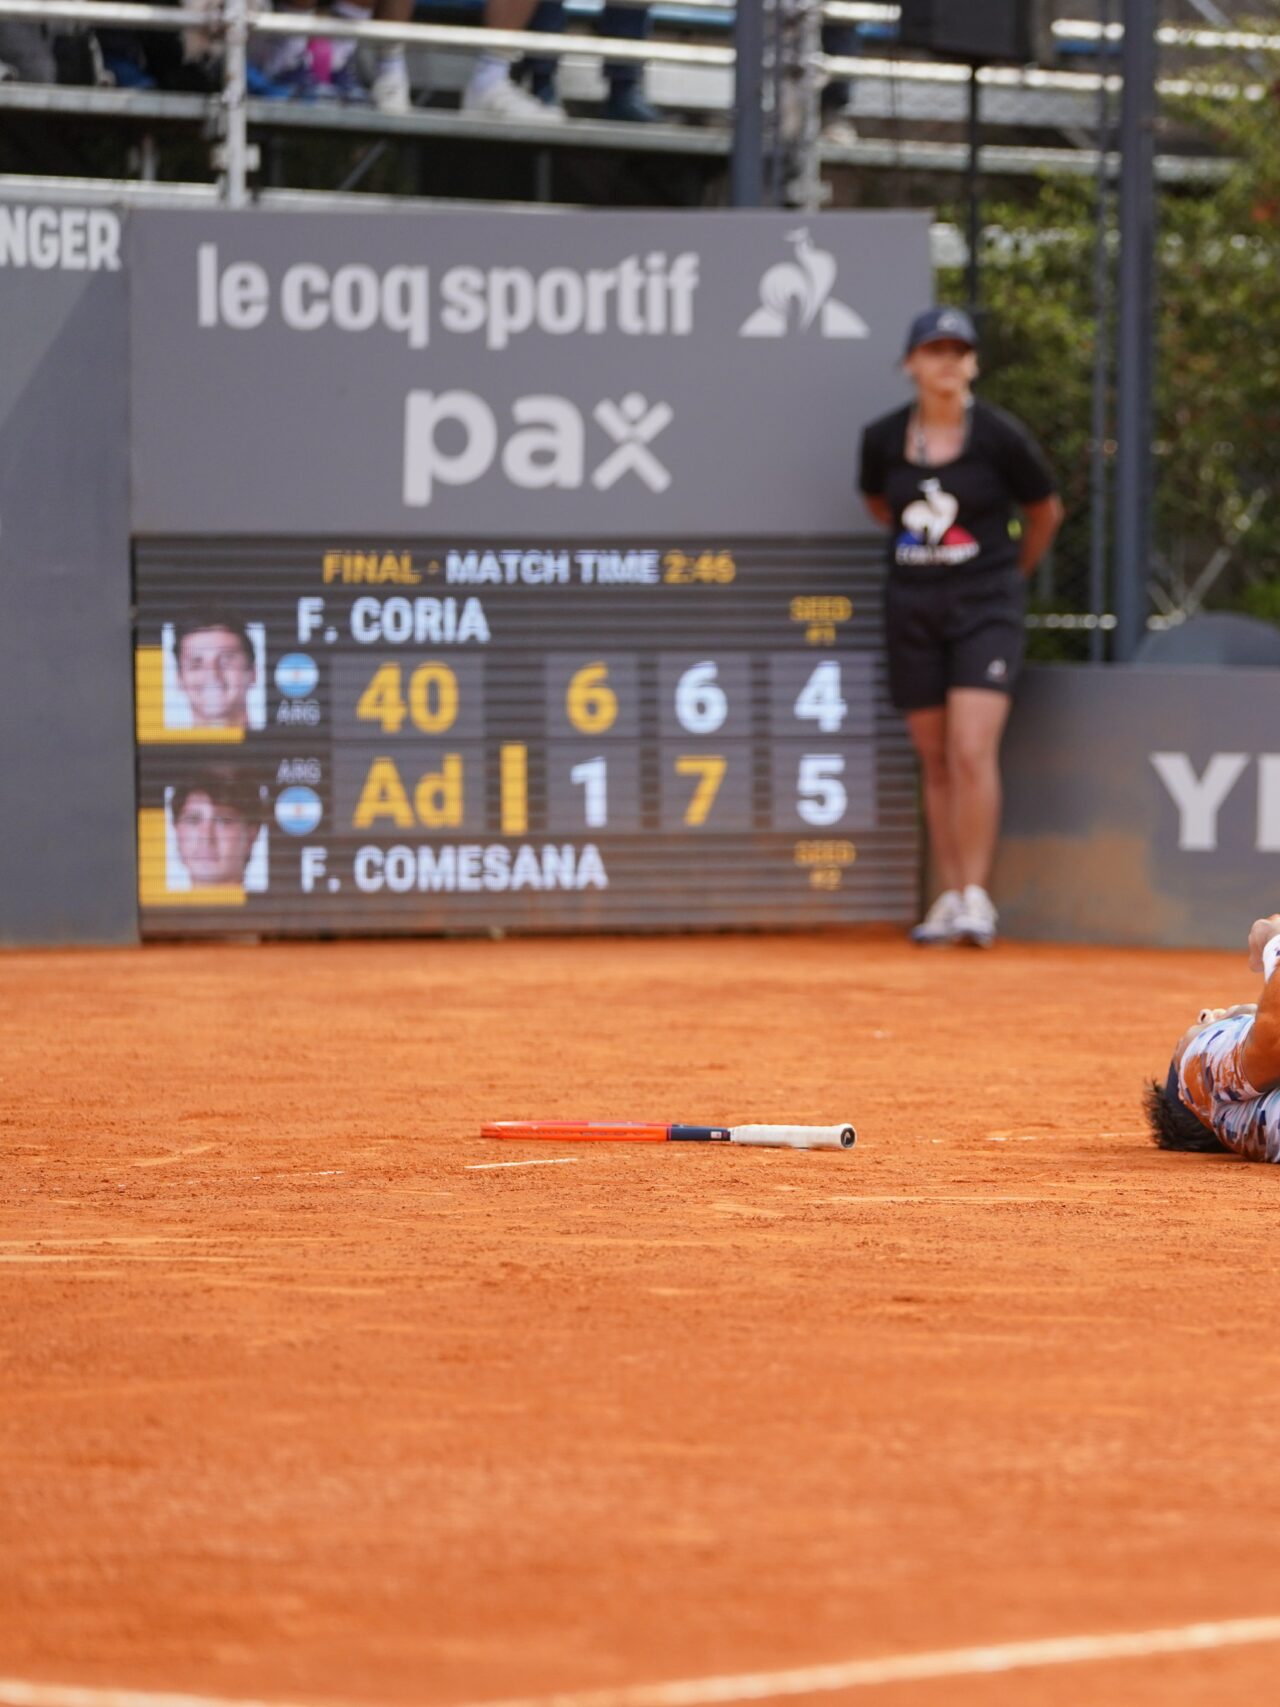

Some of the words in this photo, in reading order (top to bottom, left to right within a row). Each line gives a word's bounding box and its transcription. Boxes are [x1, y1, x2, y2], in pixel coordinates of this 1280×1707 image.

[0, 205, 121, 271] NGER
[199, 244, 269, 329] le
[281, 263, 430, 349] coq
[440, 251, 699, 349] sportif
[403, 389, 674, 508] pax
[322, 550, 422, 584] FINAL
[445, 549, 570, 584] MATCH
[575, 549, 661, 584] TIME
[298, 596, 339, 643] F.
[350, 596, 491, 644] CORIA
[276, 698, 320, 726] ARG
[356, 660, 459, 733] 40
[566, 661, 618, 734] 6
[675, 660, 728, 734] 6
[793, 660, 848, 733] 4
[276, 757, 321, 785] ARG
[352, 753, 463, 828] Ad
[570, 755, 608, 828] 1
[675, 754, 728, 826] 7
[797, 753, 848, 826] 5
[301, 845, 341, 892] F.
[354, 844, 608, 892] COMESANA
